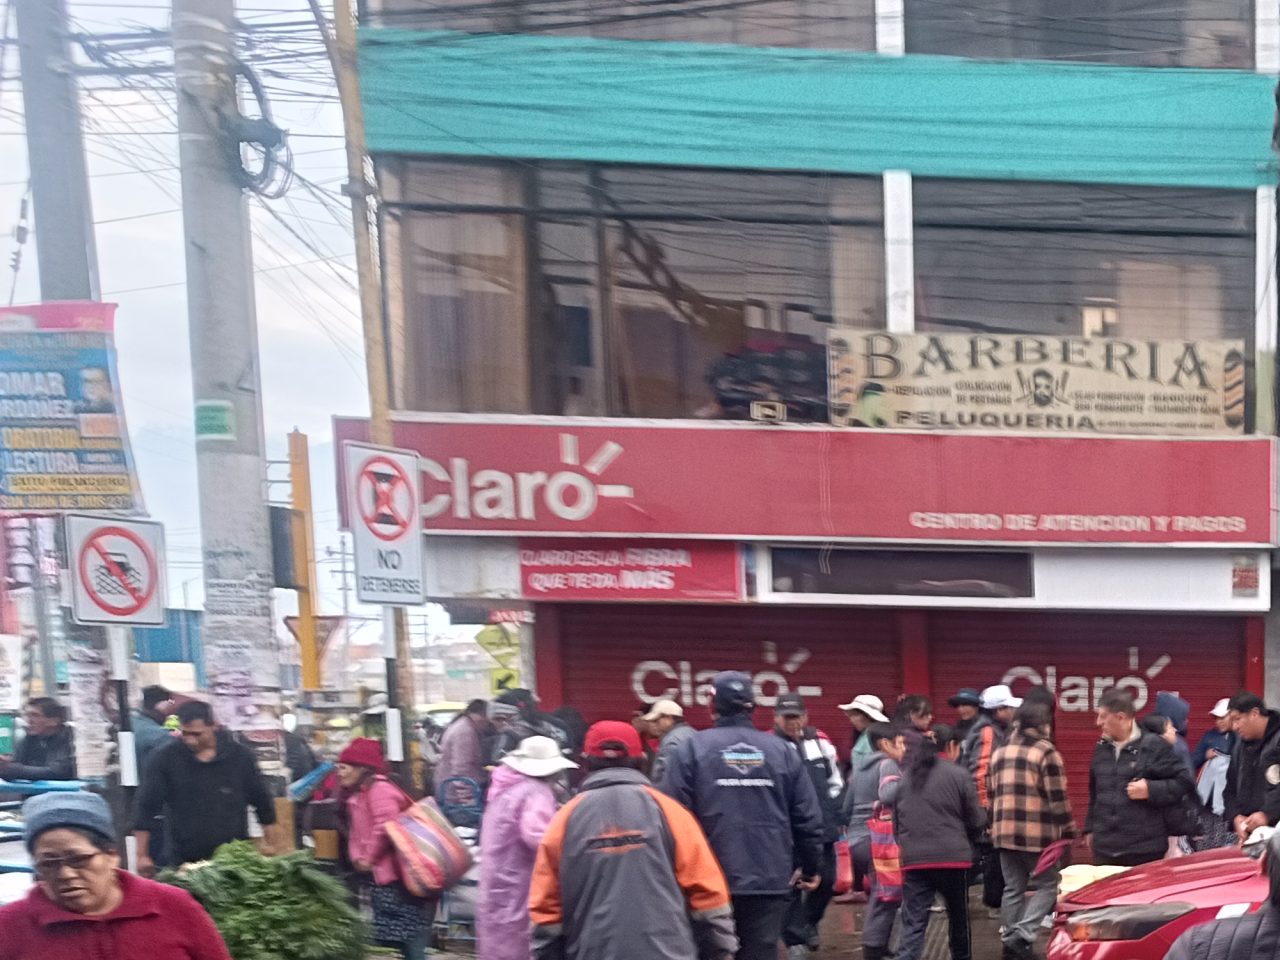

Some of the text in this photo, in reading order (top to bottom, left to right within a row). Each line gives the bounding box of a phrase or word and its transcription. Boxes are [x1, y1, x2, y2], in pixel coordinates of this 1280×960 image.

[865, 333, 1217, 392] BARBERIA
[895, 410, 1097, 430] PELUQUERIA
[909, 512, 1002, 530] CENTRO
[1003, 514, 1037, 531] DE
[1151, 515, 1171, 532] Y
[1172, 515, 1247, 532] PAGOS
[377, 548, 402, 570] NO
[528, 573, 568, 592] QUE
[568, 573, 592, 589] TE
[592, 573, 619, 590] DA
[632, 660, 789, 707] Clao
